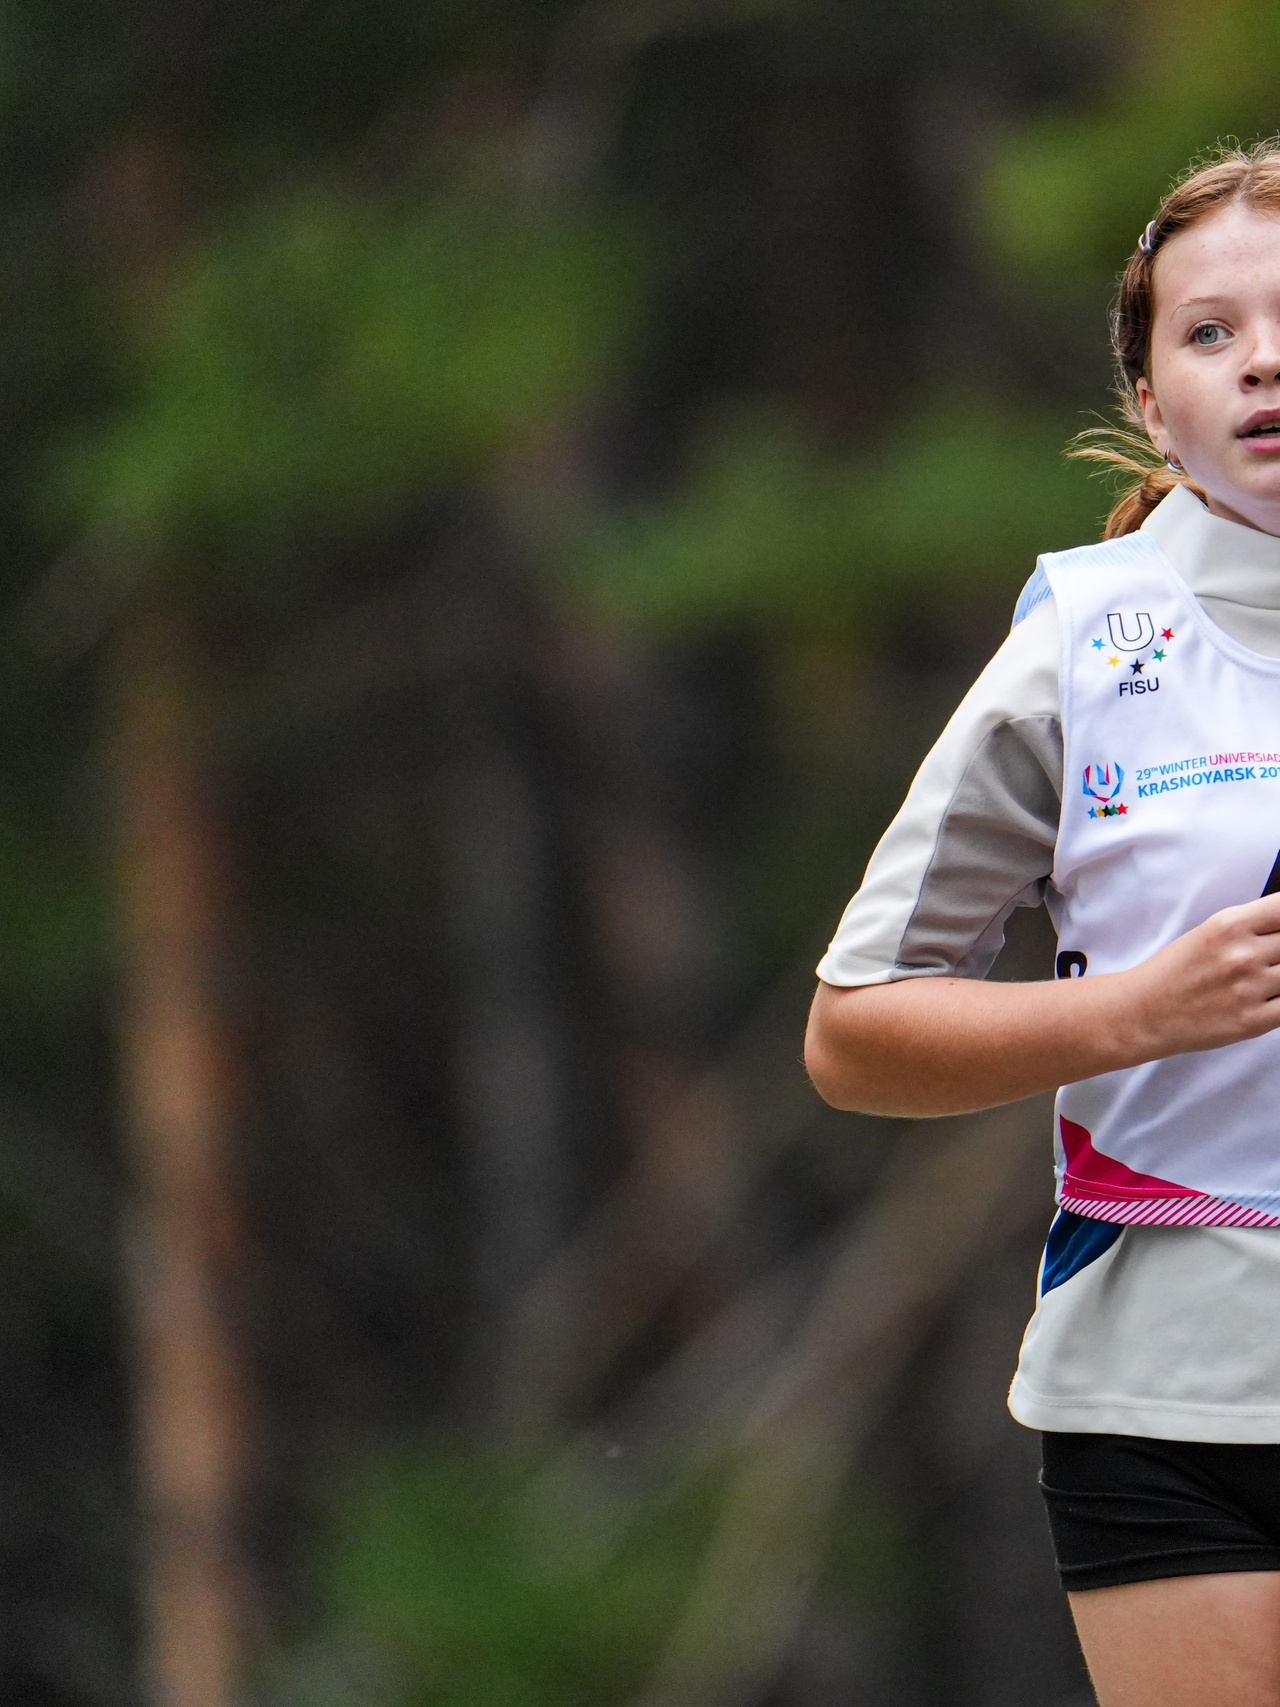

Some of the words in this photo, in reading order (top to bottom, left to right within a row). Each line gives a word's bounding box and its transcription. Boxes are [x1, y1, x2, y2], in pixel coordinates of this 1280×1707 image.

[1119, 677, 1160, 696] FISU
[1159, 756, 1208, 776] WINTER
[1137, 766, 1256, 798] KRASNOYARSK
